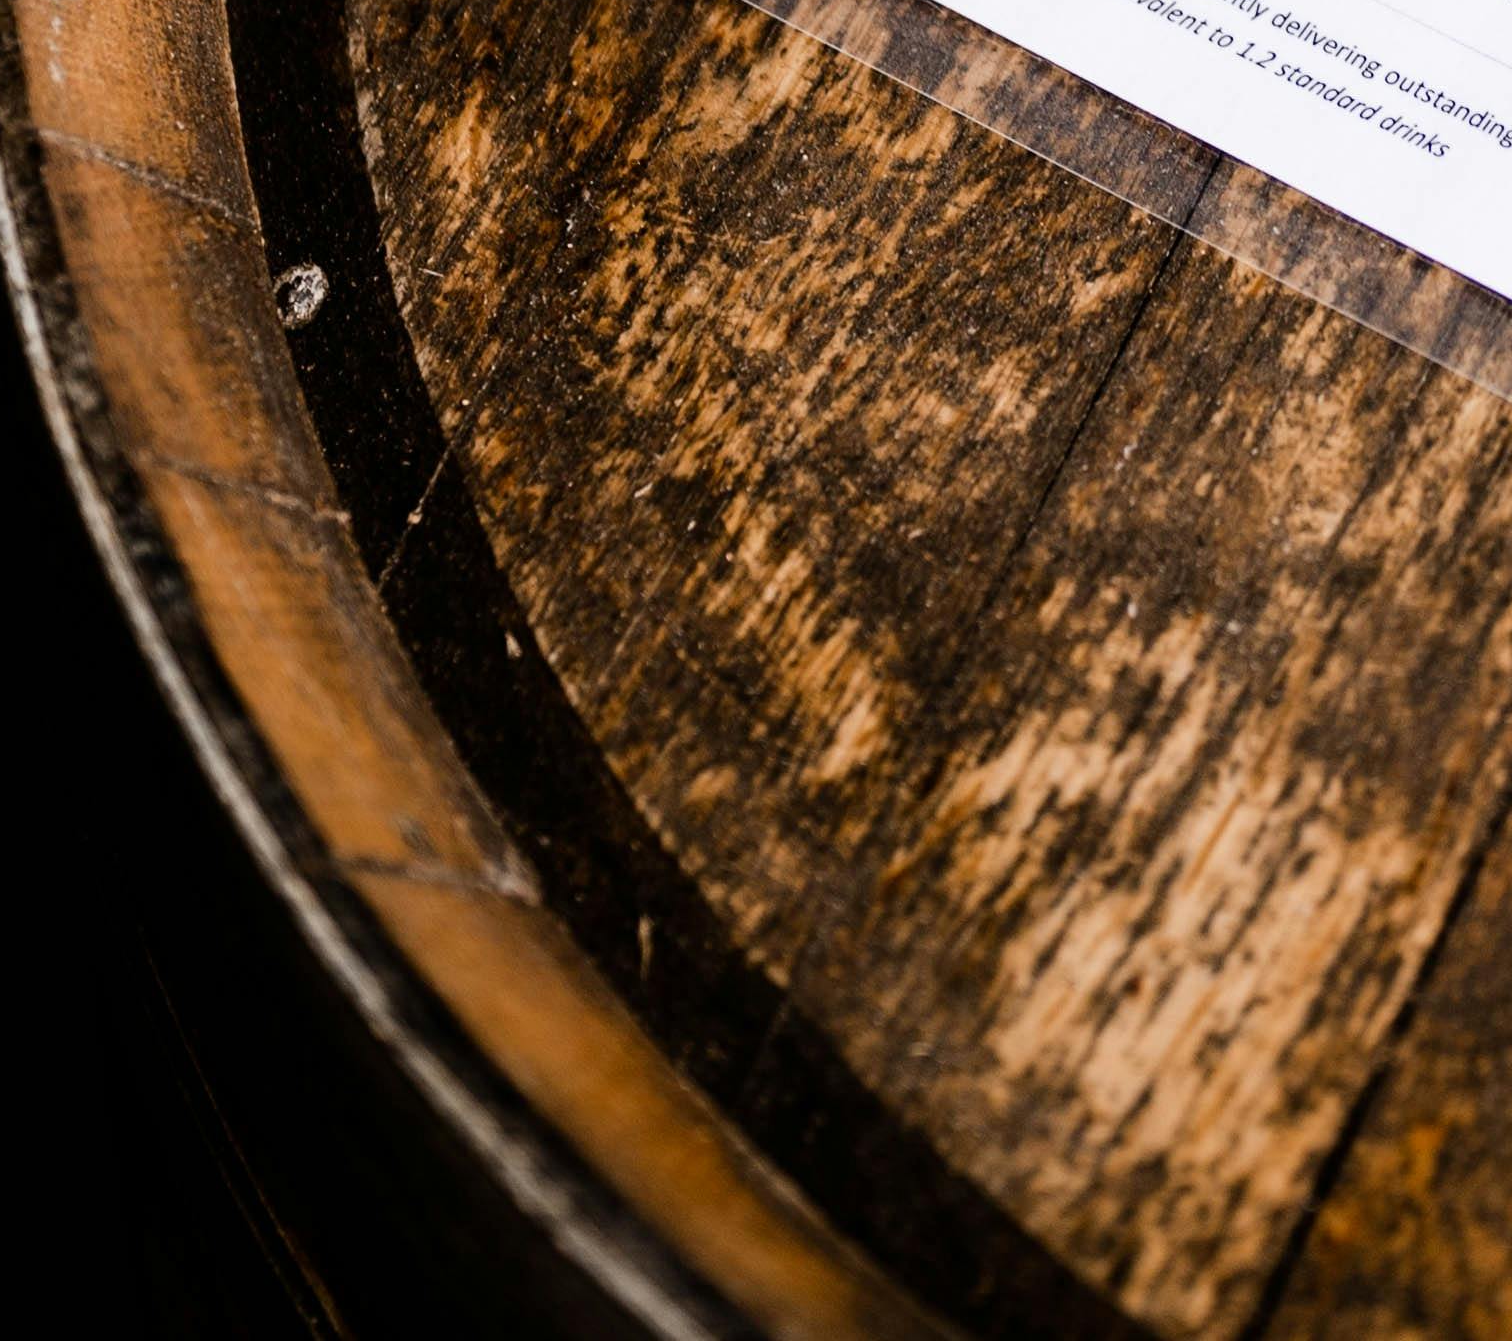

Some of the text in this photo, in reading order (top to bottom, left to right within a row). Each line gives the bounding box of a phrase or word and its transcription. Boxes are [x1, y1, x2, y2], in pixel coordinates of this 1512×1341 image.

[1208, 27, 1234, 48] to
[1236, 42, 1277, 69] 1.2
[1274, 64, 1383, 121] standard
[1379, 116, 1450, 157] drinks
[1271, 12, 1382, 79] delivering
